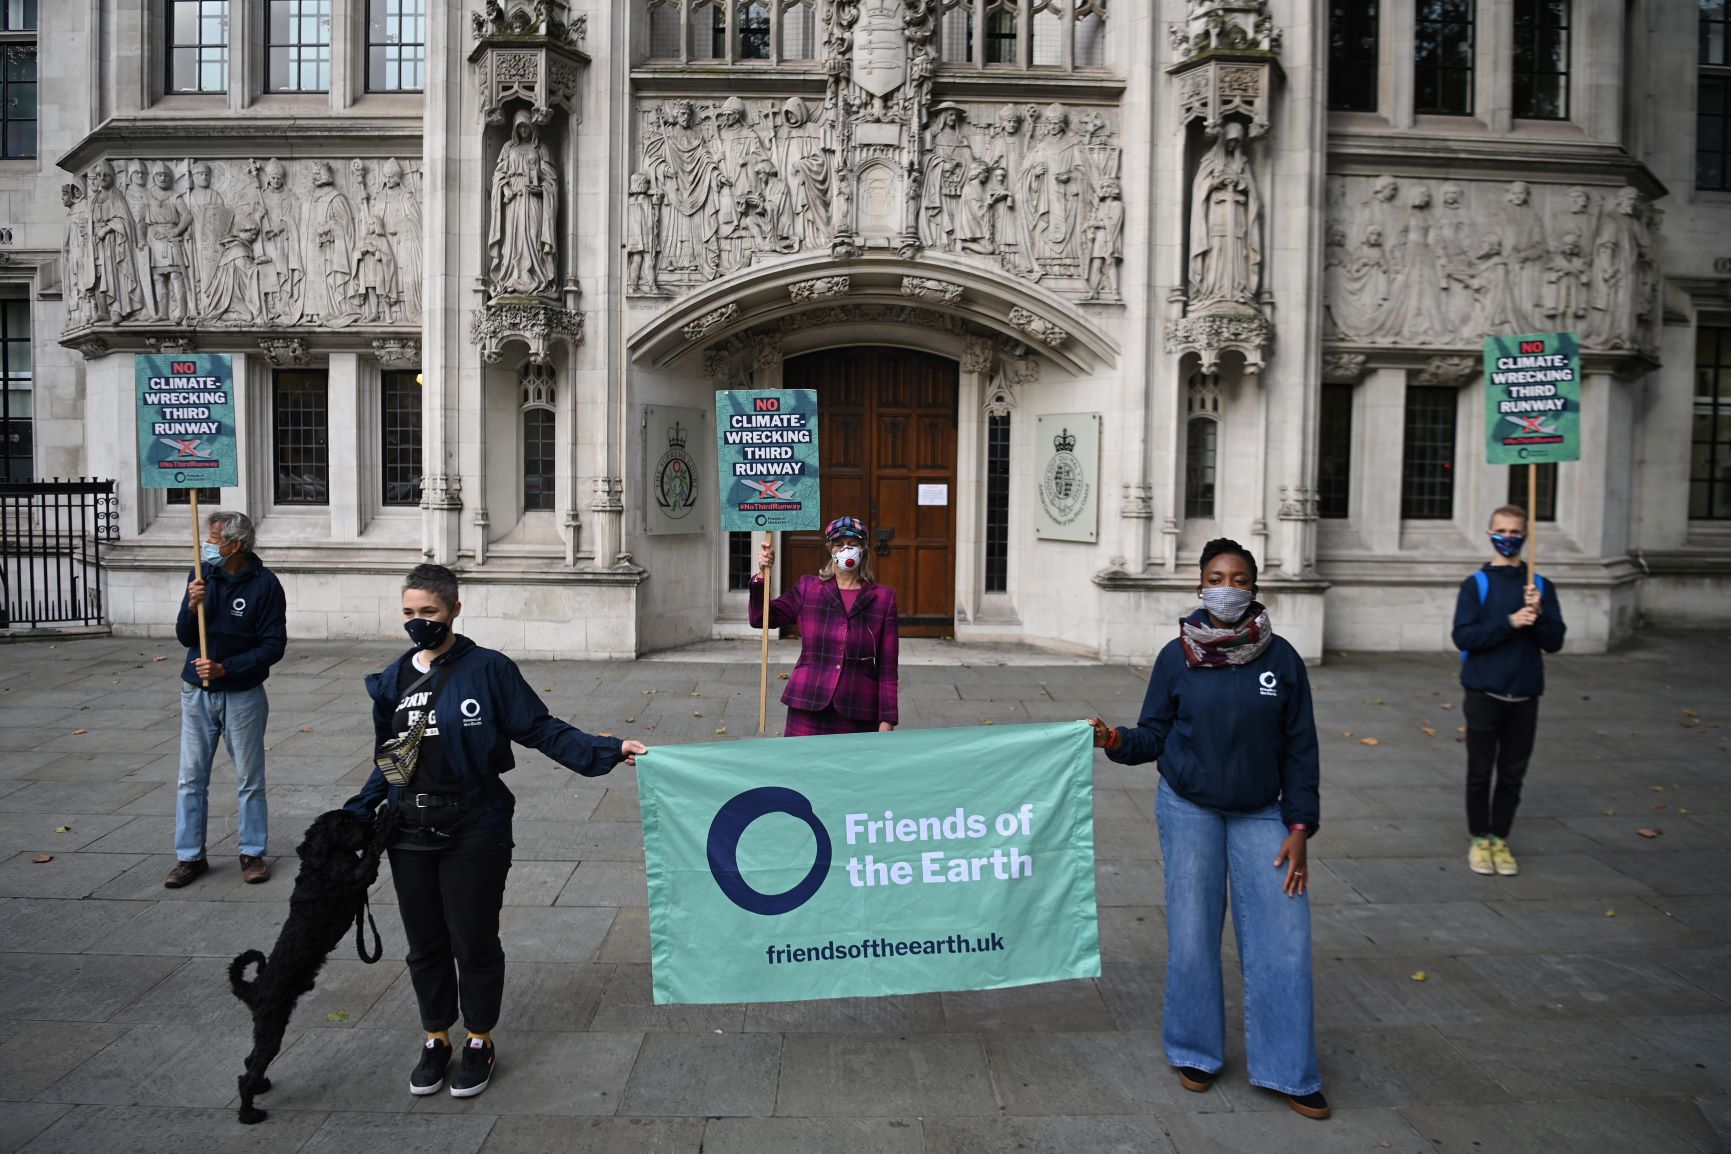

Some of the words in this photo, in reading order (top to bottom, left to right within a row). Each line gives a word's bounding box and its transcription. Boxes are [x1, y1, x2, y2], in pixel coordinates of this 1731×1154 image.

[1521, 342, 1543, 353] NO
[173, 362, 195, 374] NO
[1498, 355, 1569, 369] CLIMATE-
[150, 377, 221, 389] CLIMATE-
[1492, 369, 1573, 384] WRECKING
[1509, 385, 1556, 398] THIRD
[144, 392, 225, 405] WRECKING
[756, 399, 778, 411] NO
[1500, 399, 1565, 413] RUNWAY
[162, 407, 209, 419] THIRD
[731, 414, 806, 428] CLIMATE-
[154, 422, 219, 435] RUNWAY
[726, 430, 810, 443] WRECKING
[744, 446, 793, 460] THIRD
[735, 462, 803, 476] RUNWAY
[740, 502, 801, 511] #NoThirdRunway
[407, 709, 437, 727] HG
[845, 807, 988, 845] Friends
[995, 803, 1034, 837] of
[845, 854, 913, 888] the
[921, 847, 1033, 884] Earth
[766, 932, 1005, 965] friendsoftheearth.uk
